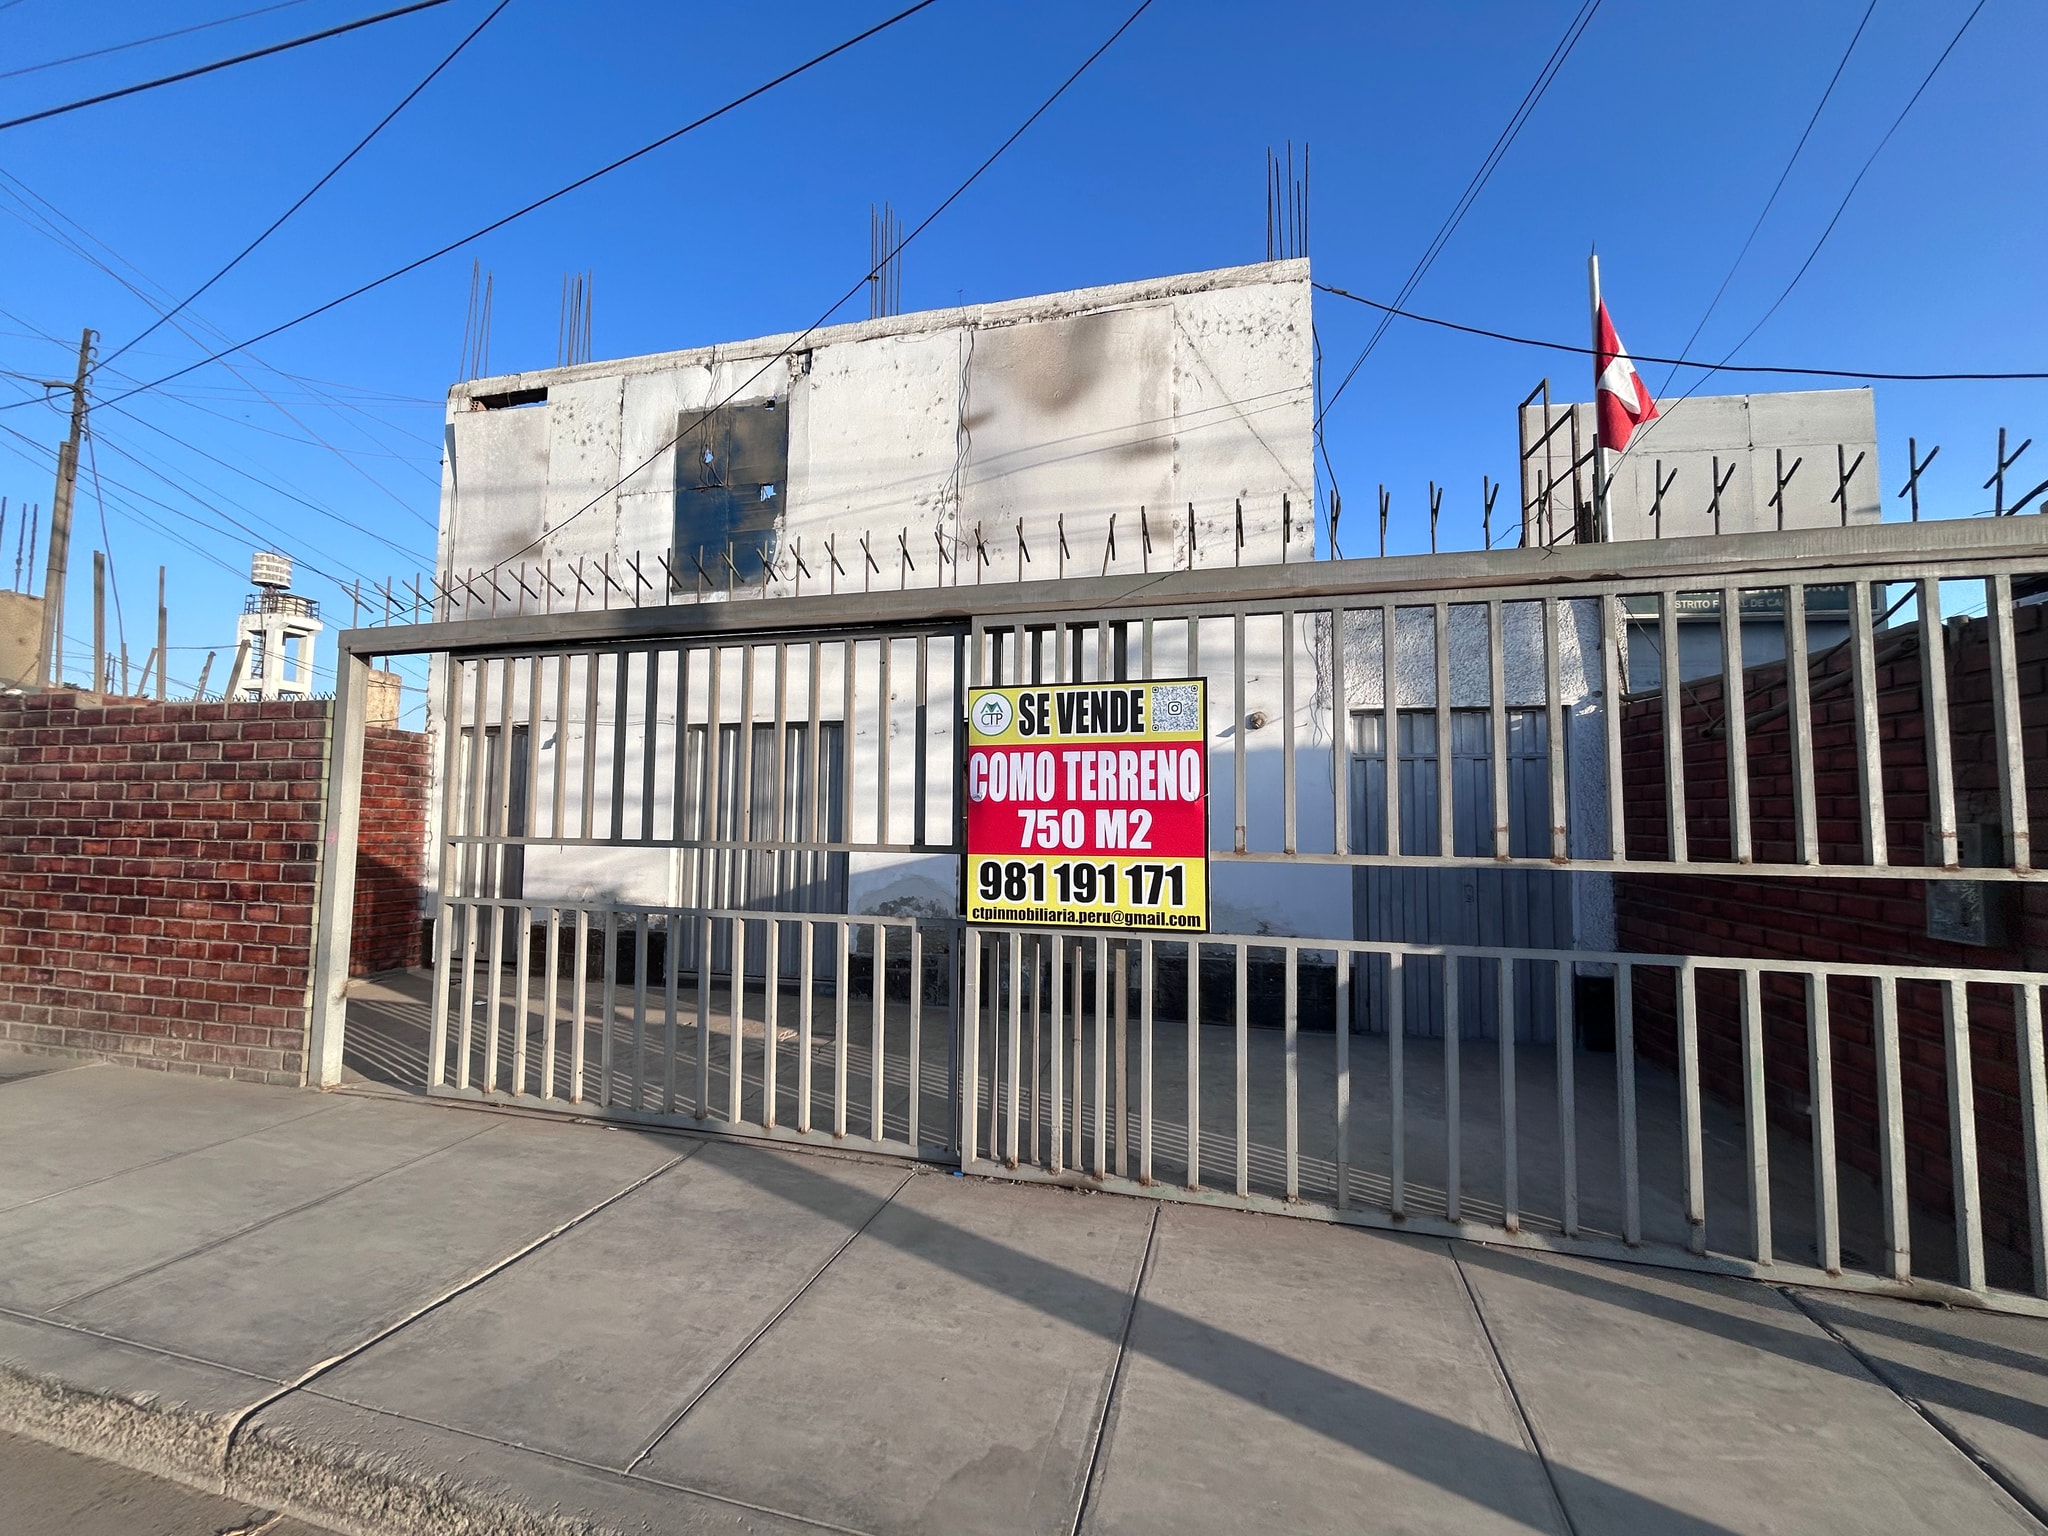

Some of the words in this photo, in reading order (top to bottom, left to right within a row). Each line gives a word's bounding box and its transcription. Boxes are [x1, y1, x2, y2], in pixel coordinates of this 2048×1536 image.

[1674, 599, 1710, 609] STRITO
[981, 712, 1003, 726] CTP
[1018, 692, 1050, 736] SE
[1056, 690, 1144, 735] VENDE
[970, 751, 1056, 803] COMO
[1062, 748, 1200, 802] TERRENO
[1018, 808, 1085, 849] 750
[1095, 808, 1153, 849] M2
[980, 861, 1044, 902] 981
[1054, 863, 1115, 904] 191
[1125, 864, 1184, 906] 171
[972, 907, 1201, 928] ctpinmobiliaria.peru@gmail.com
